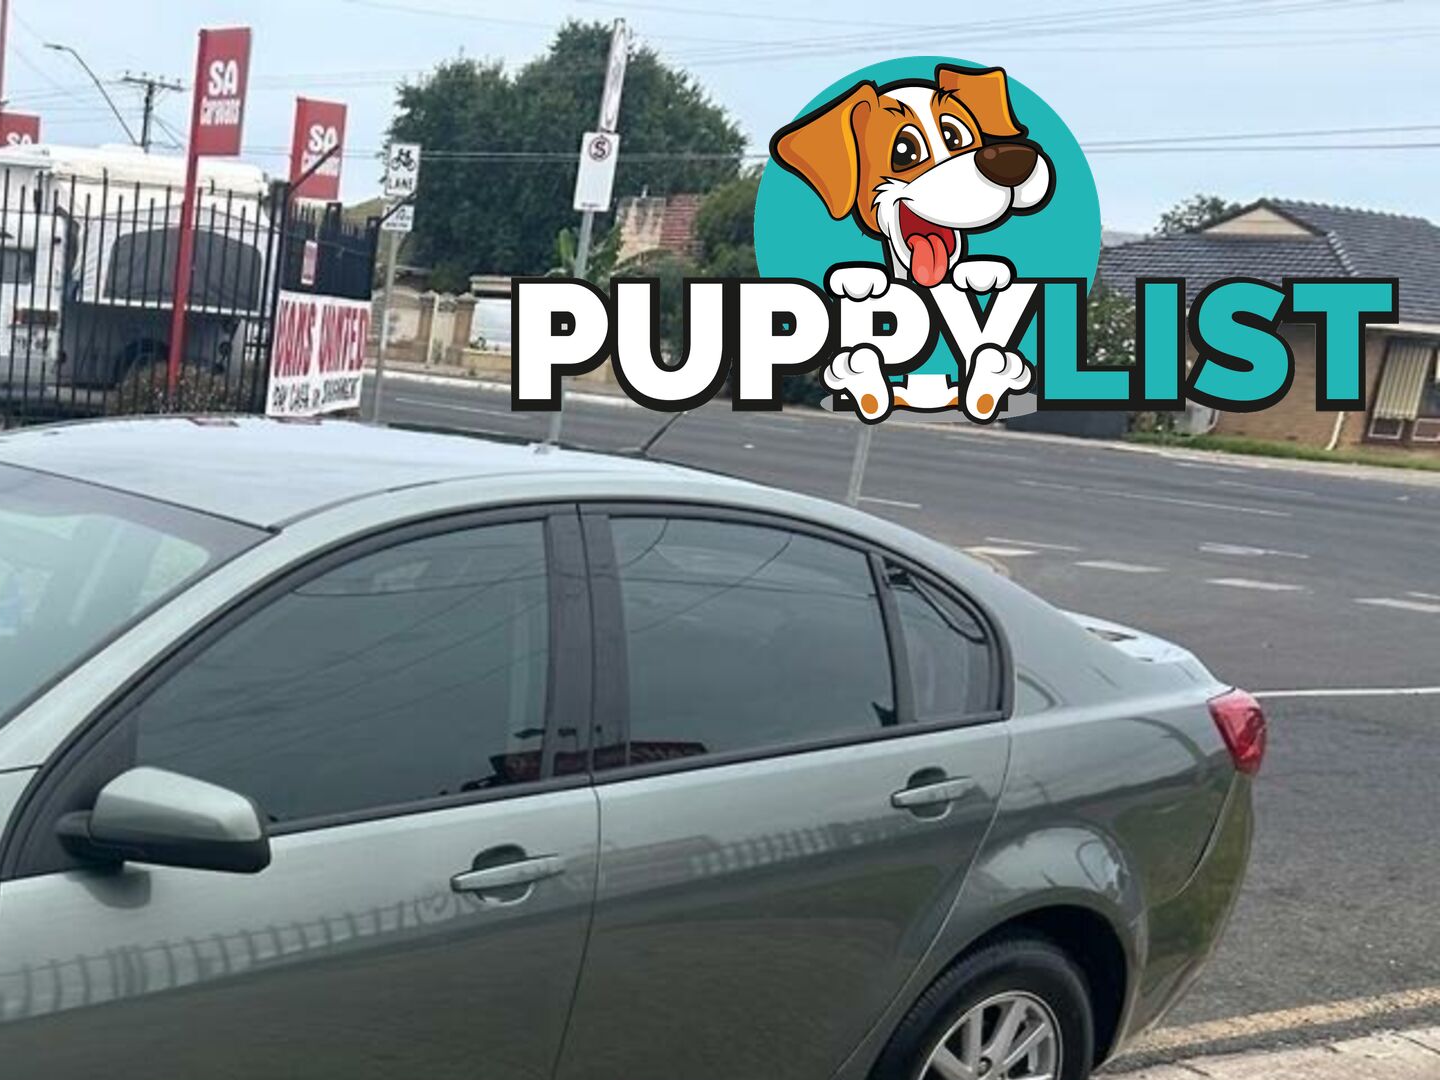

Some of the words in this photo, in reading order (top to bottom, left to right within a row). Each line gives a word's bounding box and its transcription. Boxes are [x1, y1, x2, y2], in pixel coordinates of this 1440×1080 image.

[208, 60, 239, 96] SA
[309, 124, 338, 154] SA
[274, 300, 317, 378] VANS
[318, 304, 371, 375] WANTED
